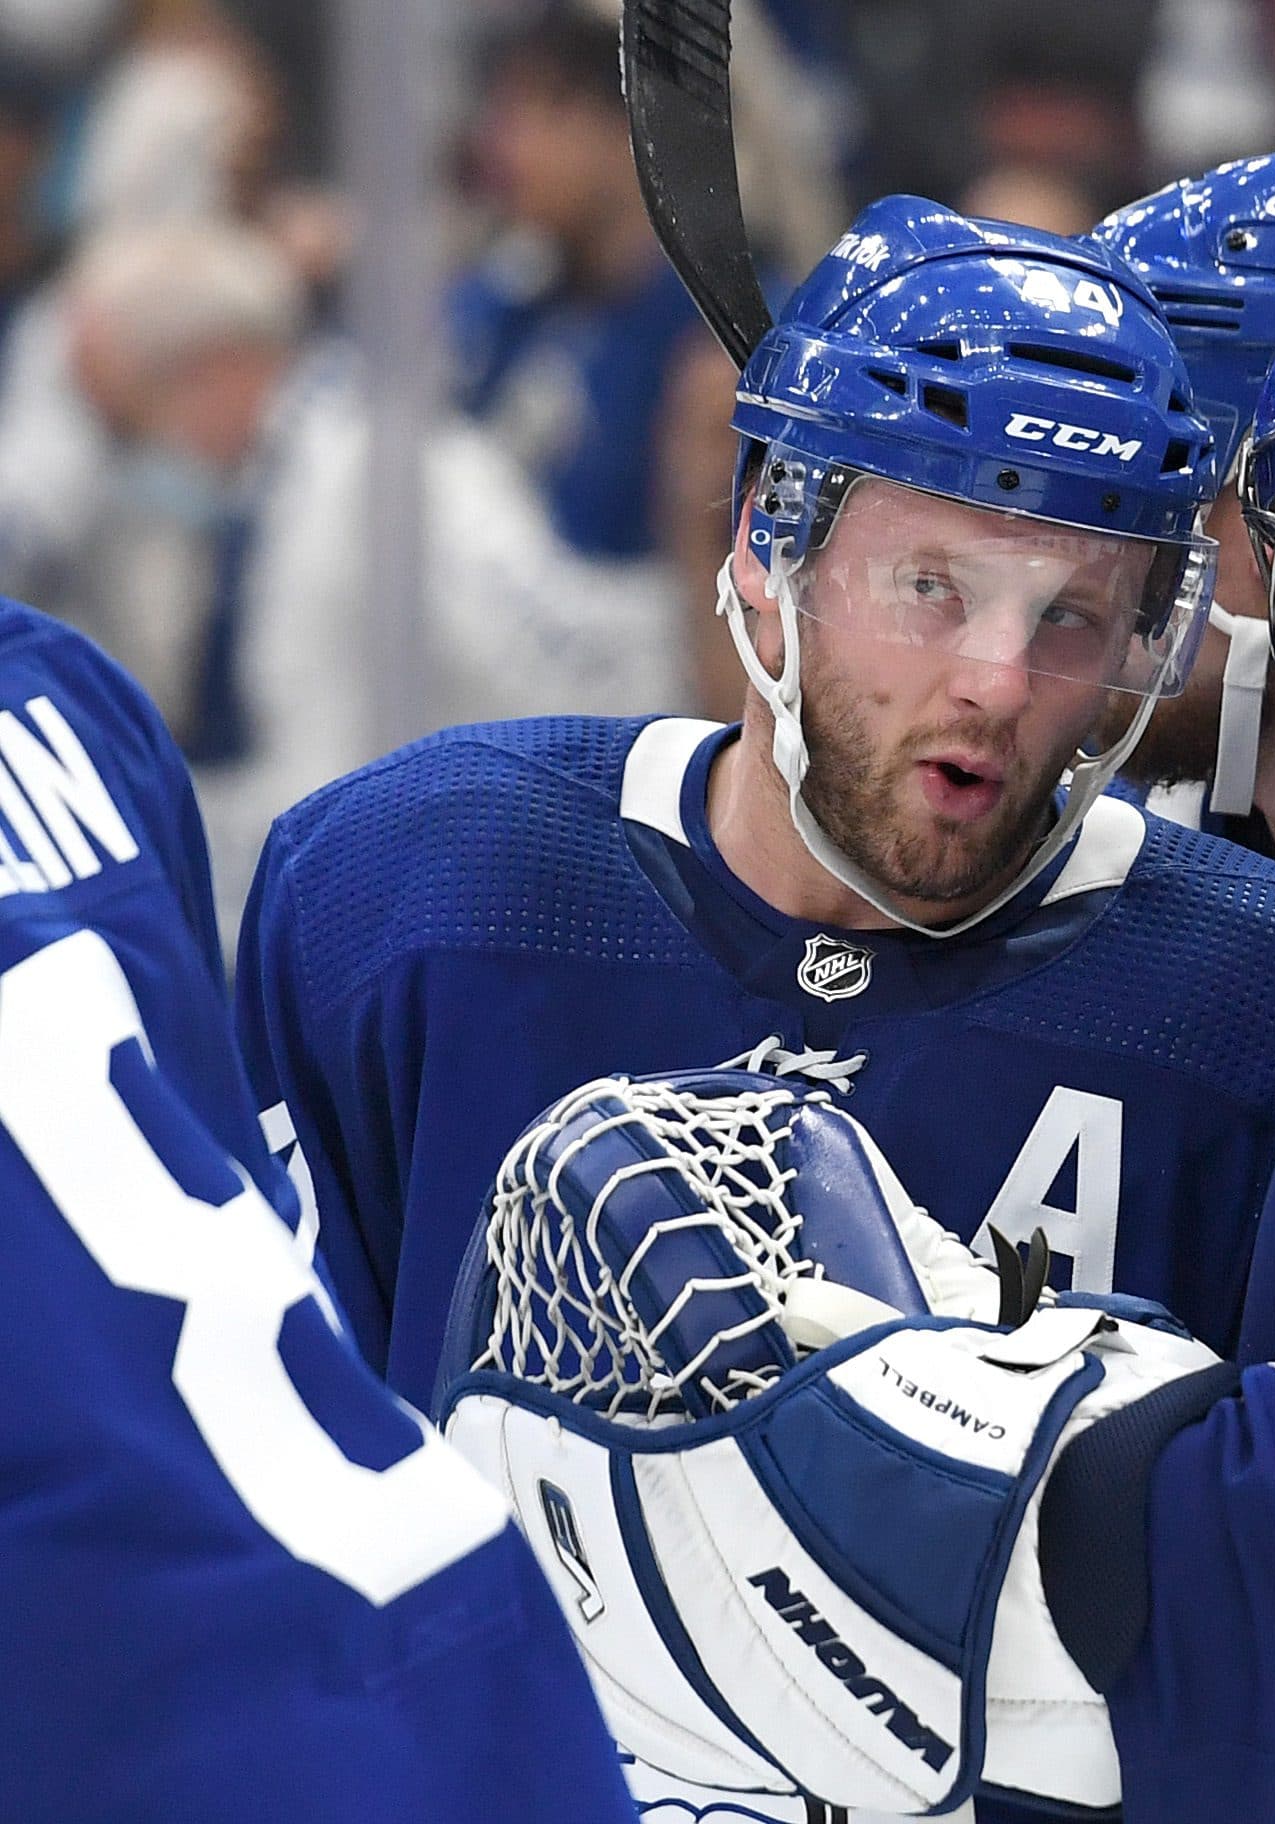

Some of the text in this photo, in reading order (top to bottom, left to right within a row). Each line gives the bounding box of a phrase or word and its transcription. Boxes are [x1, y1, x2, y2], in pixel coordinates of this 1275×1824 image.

[1004, 412, 1142, 461] CCM
[814, 953, 859, 983] NHL
[971, 1085, 1124, 1295] A
[879, 1356, 1007, 1440] CAMPBELL
[746, 1565, 956, 1775] VAUGHN
